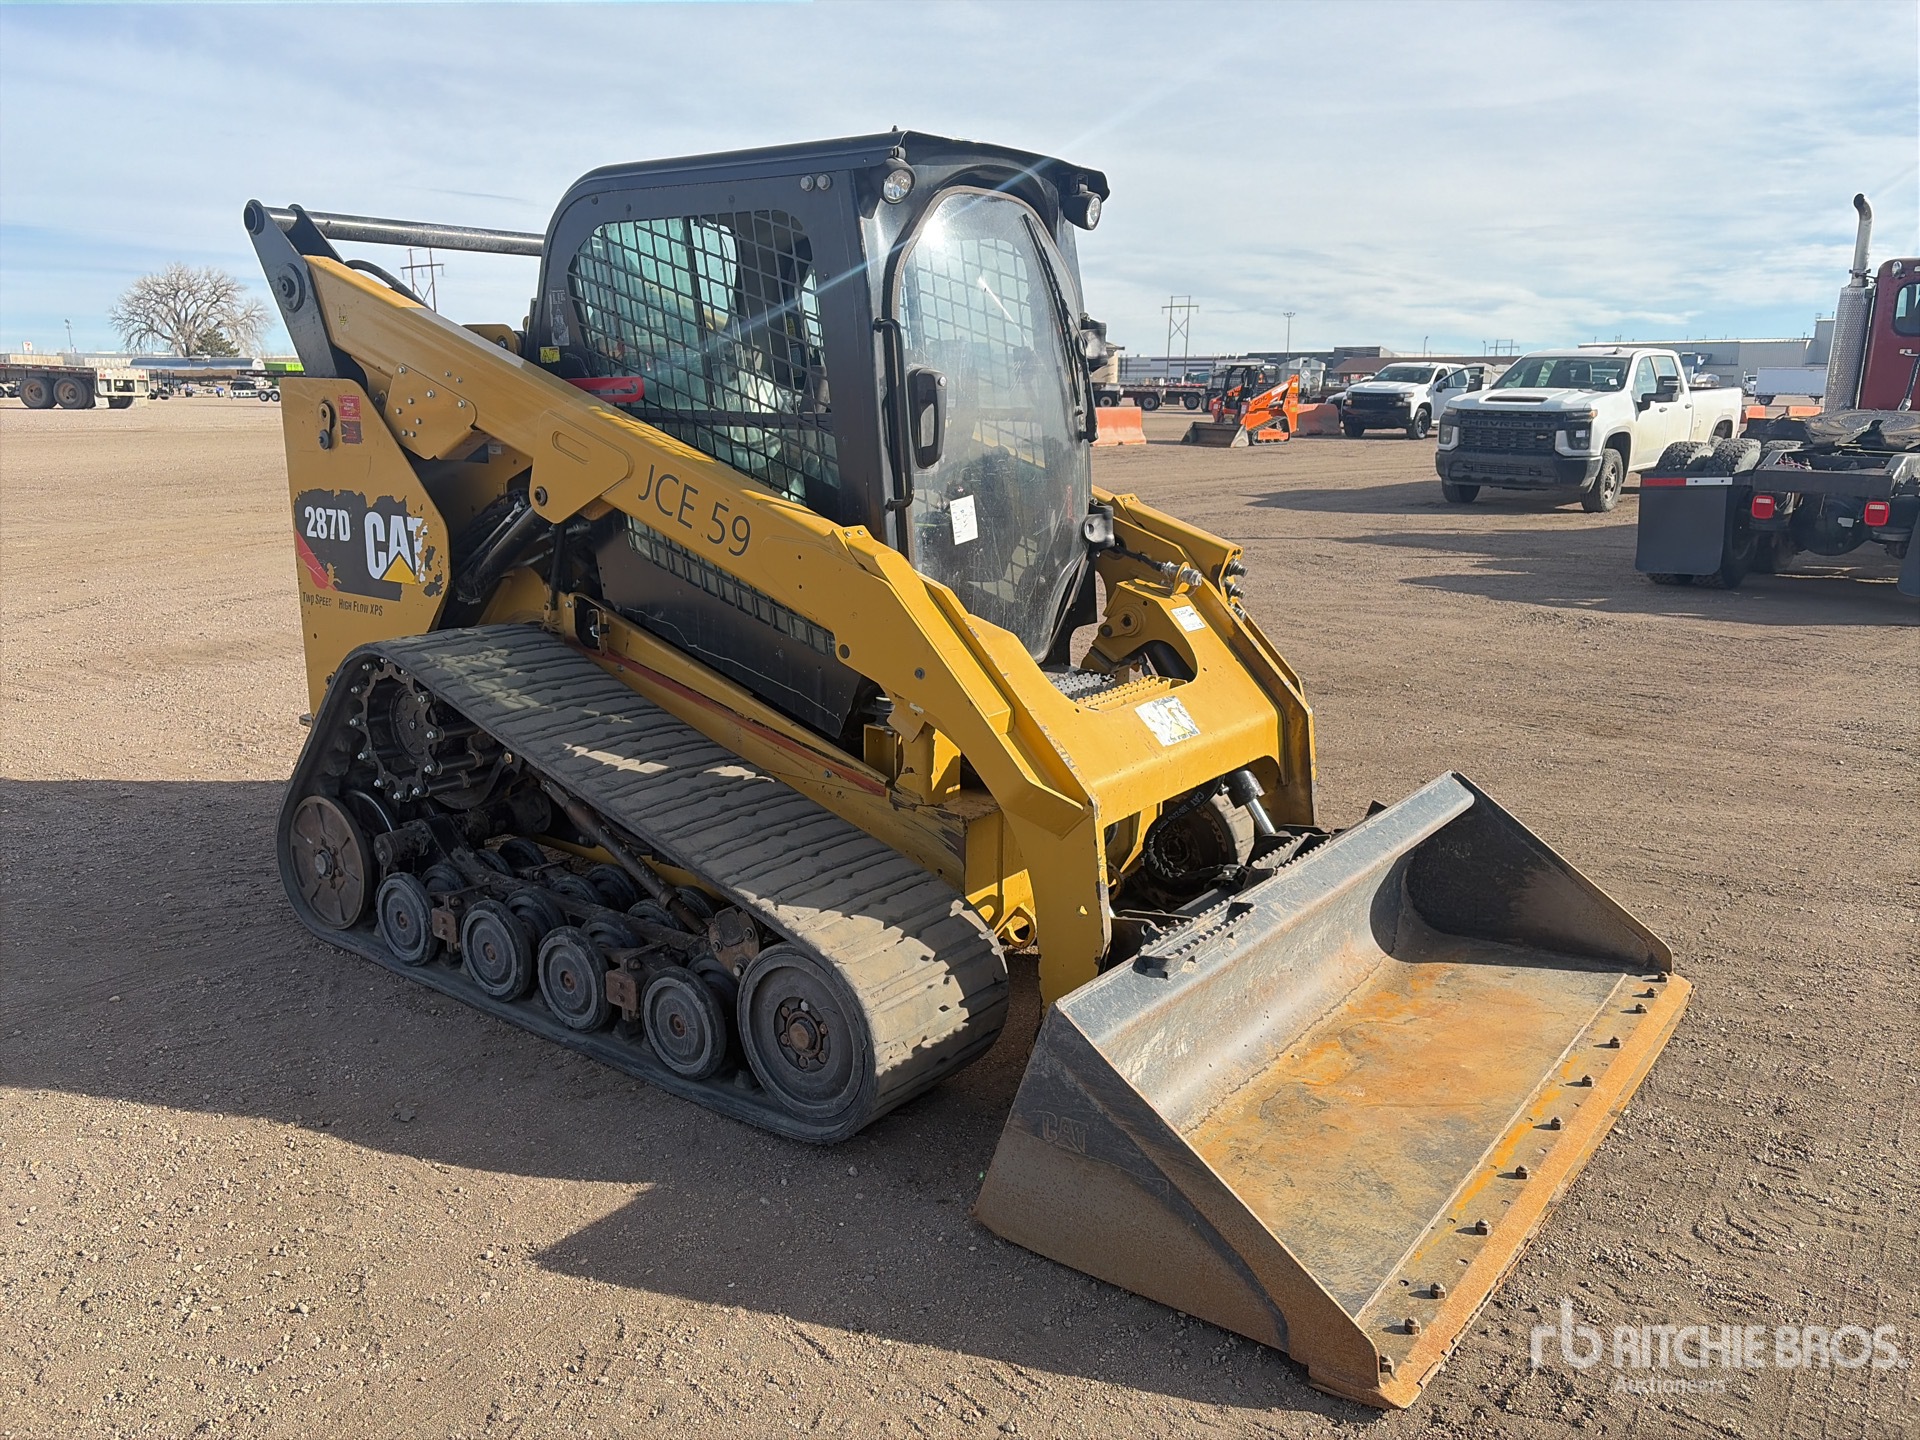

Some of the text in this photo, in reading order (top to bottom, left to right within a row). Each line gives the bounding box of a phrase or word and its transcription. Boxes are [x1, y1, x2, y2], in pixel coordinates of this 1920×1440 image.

[1460, 419, 1555, 429] CHEVROLET
[638, 464, 751, 557] JCE 59
[304, 506, 351, 542] 287D
[364, 511, 429, 583] CAT
[369, 603, 384, 617] XPS
[1190, 791, 1205, 807] CAT
